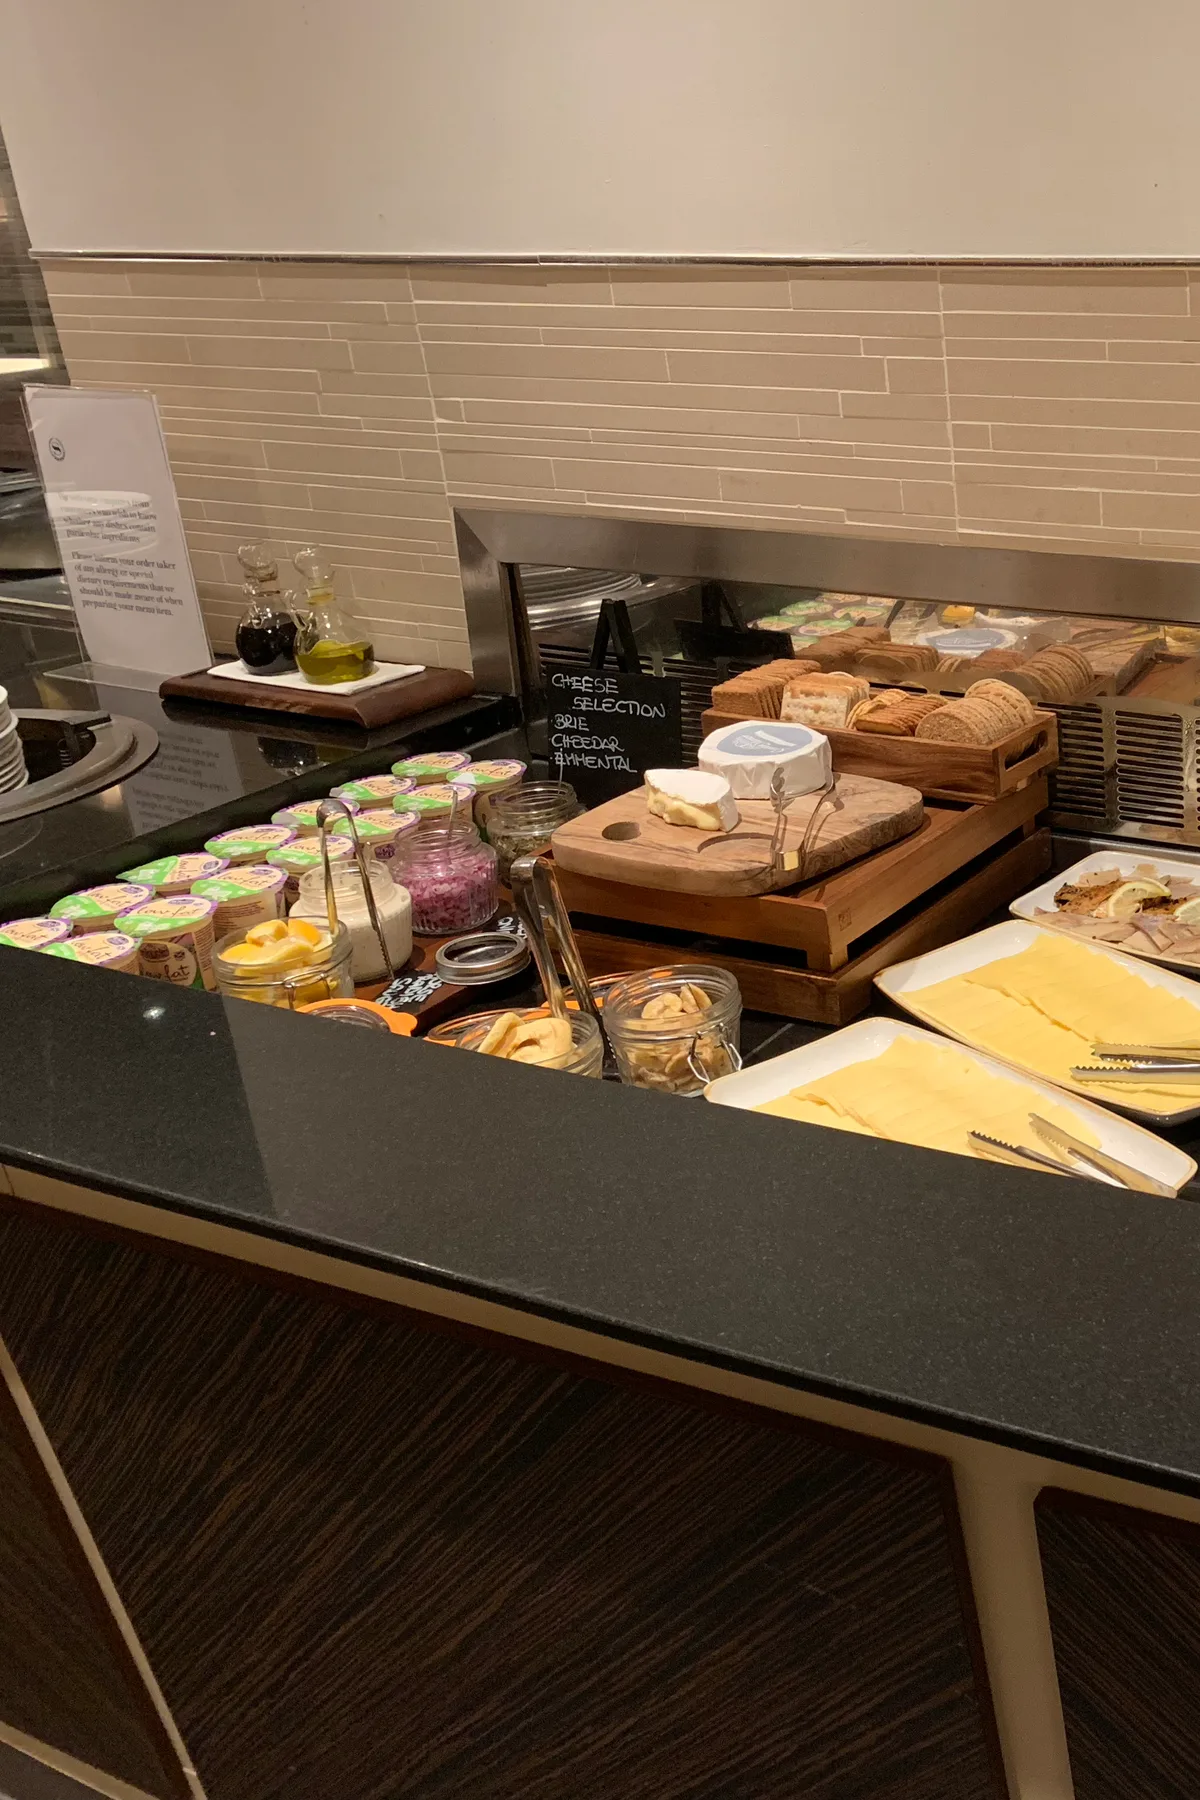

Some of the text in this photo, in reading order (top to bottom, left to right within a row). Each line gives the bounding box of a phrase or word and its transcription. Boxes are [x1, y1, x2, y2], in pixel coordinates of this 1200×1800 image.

[551, 673, 619, 694] CHEESE
[572, 697, 666, 718] SELECTION
[553, 714, 590, 731] BRIE
[554, 751, 638, 773] EMMENTAL
